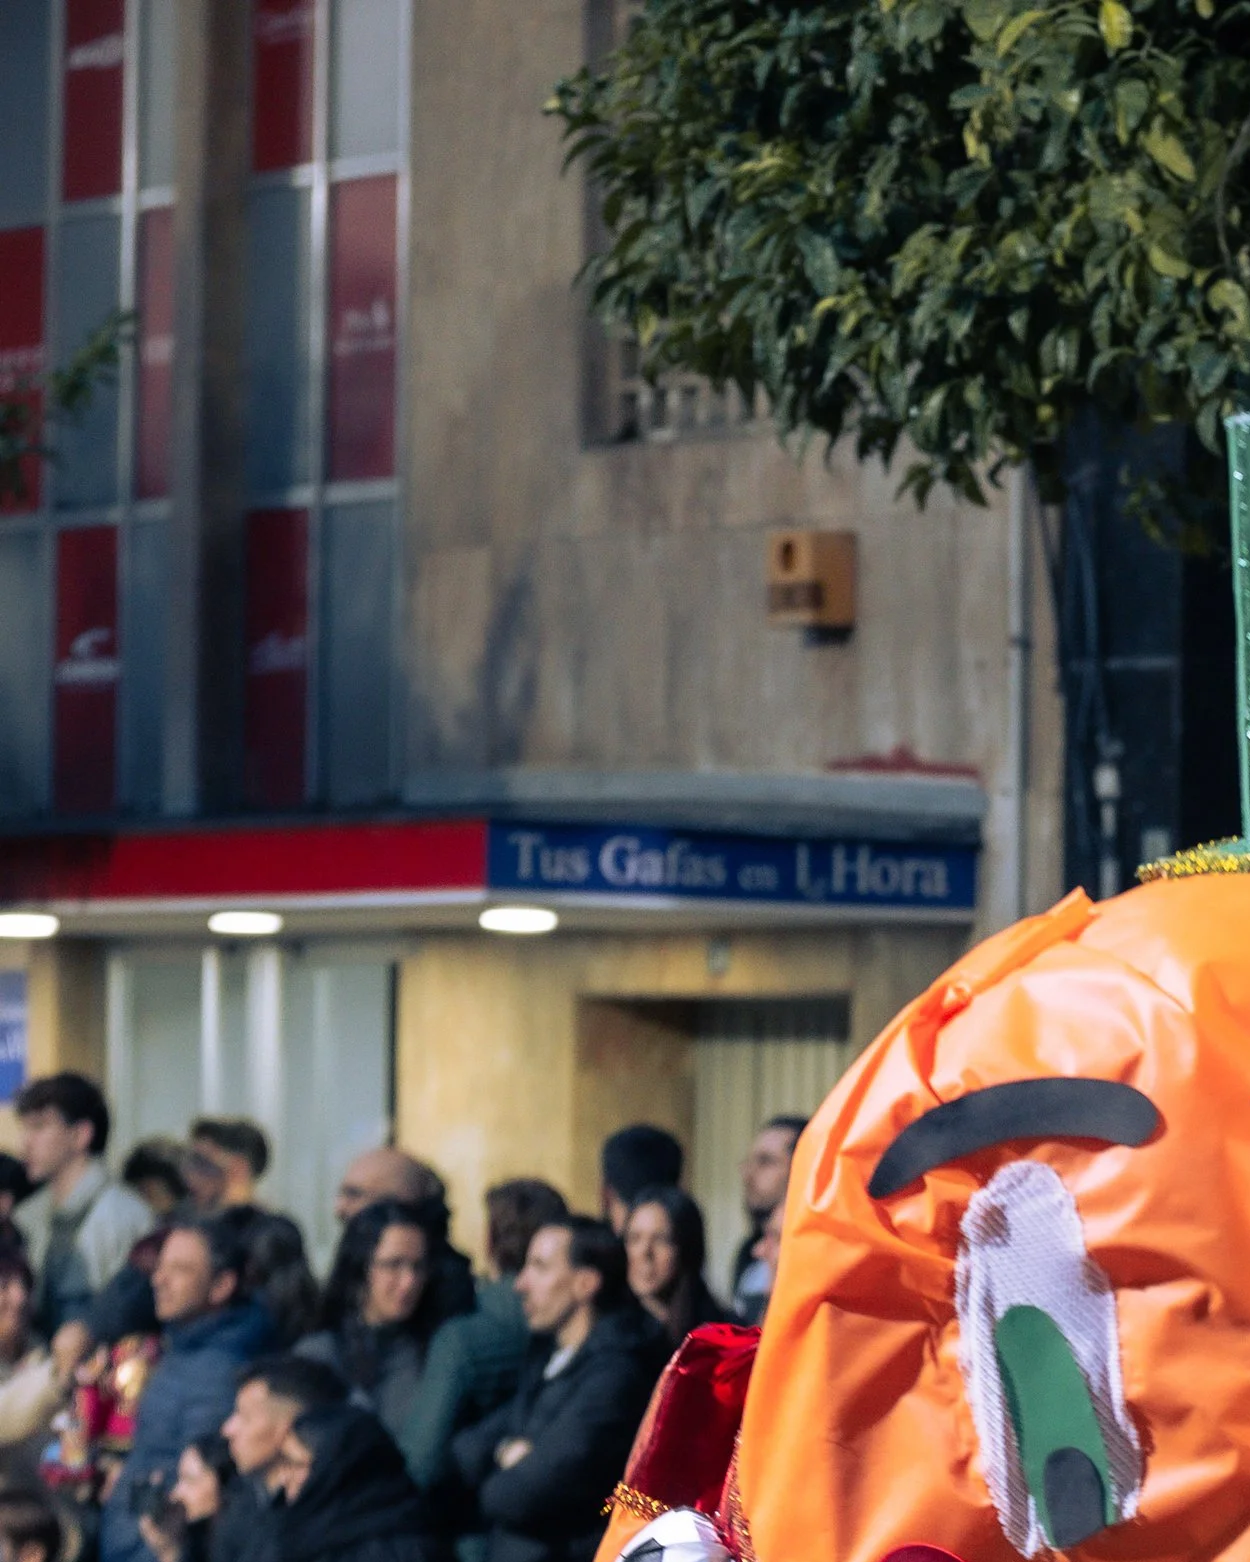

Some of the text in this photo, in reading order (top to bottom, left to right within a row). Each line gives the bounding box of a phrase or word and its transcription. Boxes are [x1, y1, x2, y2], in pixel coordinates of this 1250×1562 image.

[507, 832, 592, 882] Tus
[599, 835, 728, 888] Gafas
[832, 844, 949, 897] Hora
